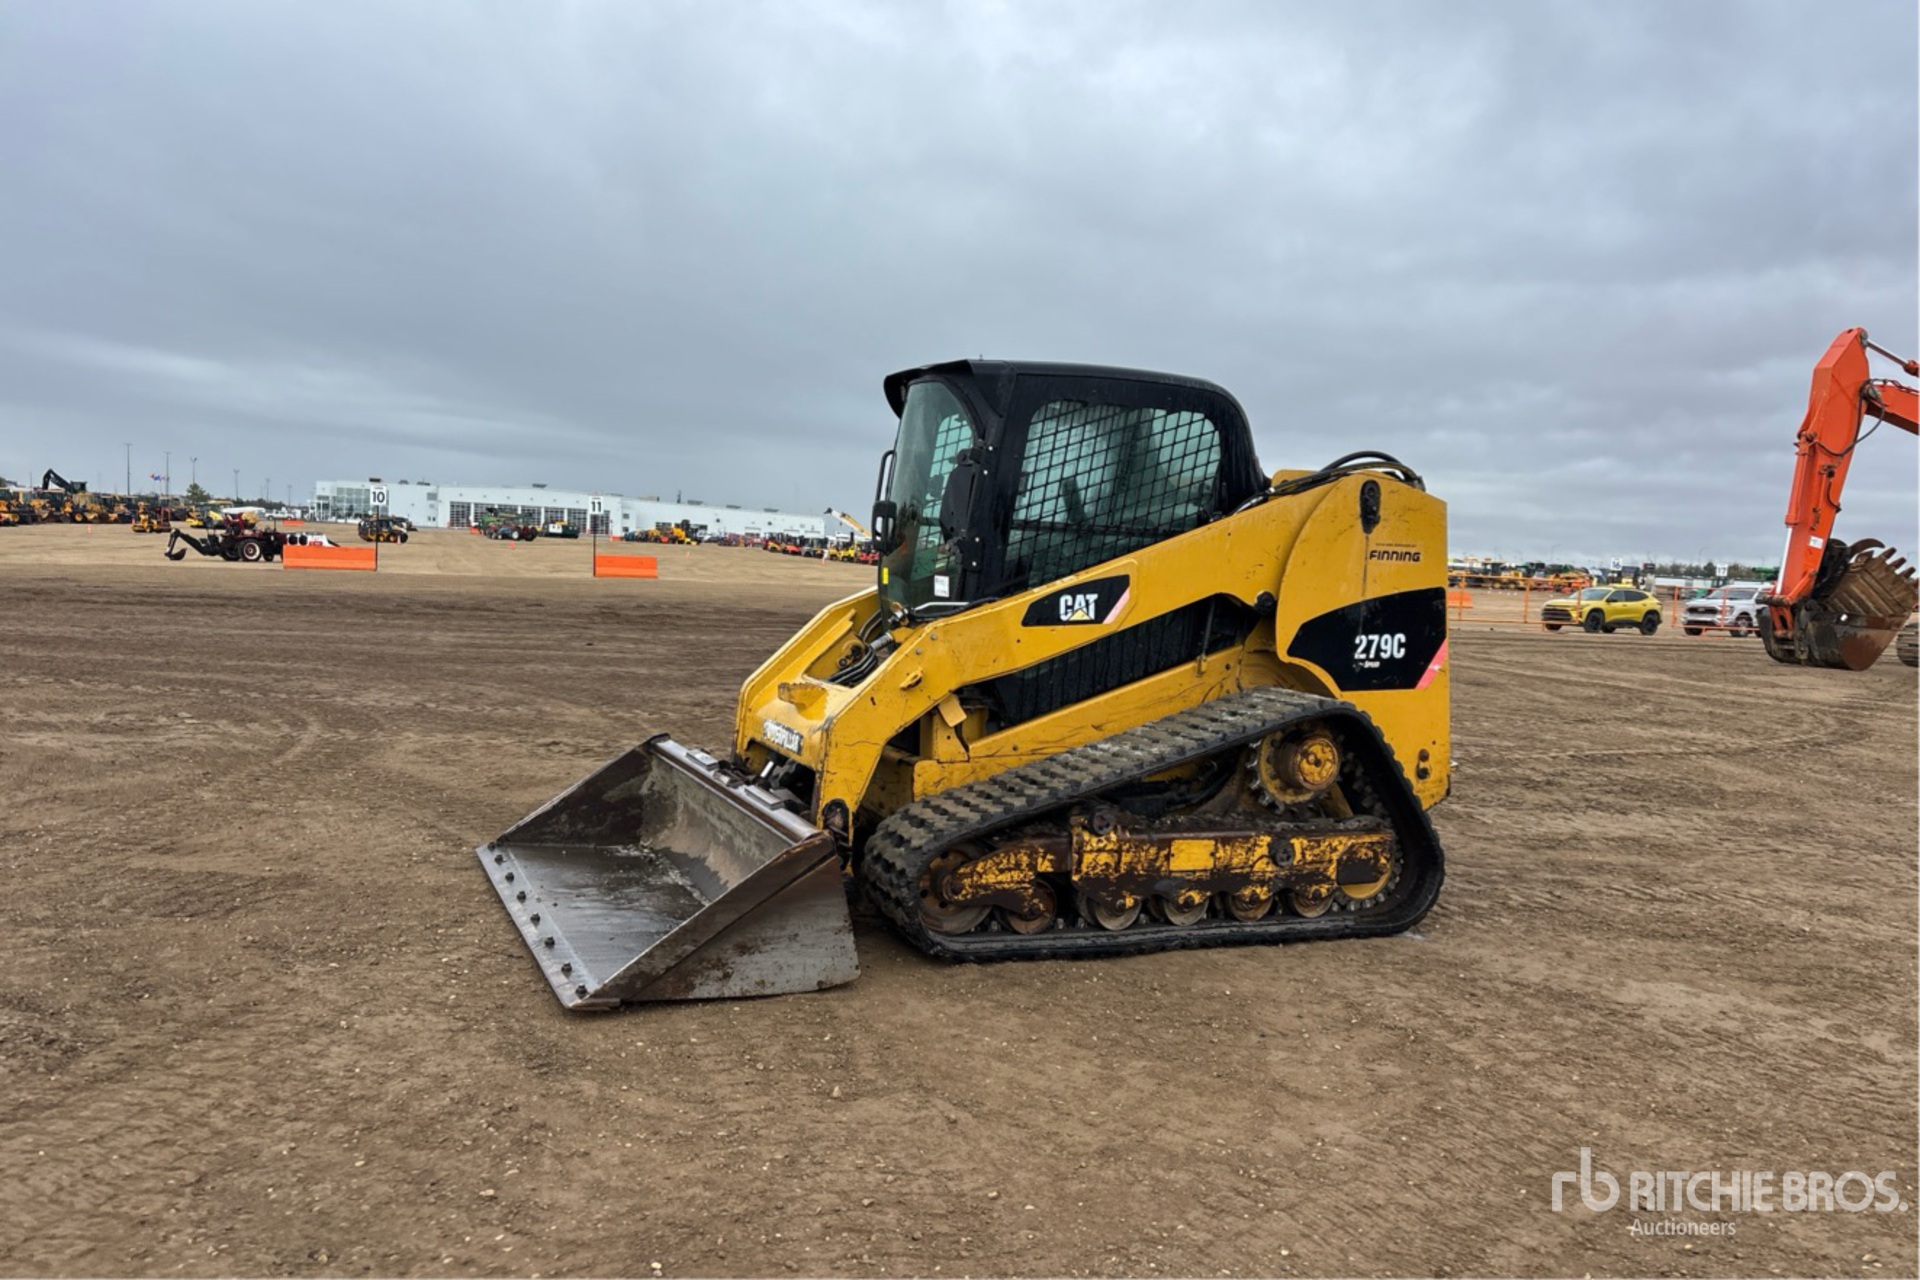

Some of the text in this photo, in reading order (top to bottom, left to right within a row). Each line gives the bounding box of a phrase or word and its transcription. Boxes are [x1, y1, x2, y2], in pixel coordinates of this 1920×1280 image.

[372, 491, 386, 503] 10
[591, 501, 602, 512] 11
[1369, 549, 1421, 562] FINNING
[1059, 593, 1098, 621] CAT
[1354, 633, 1406, 659] 279C
